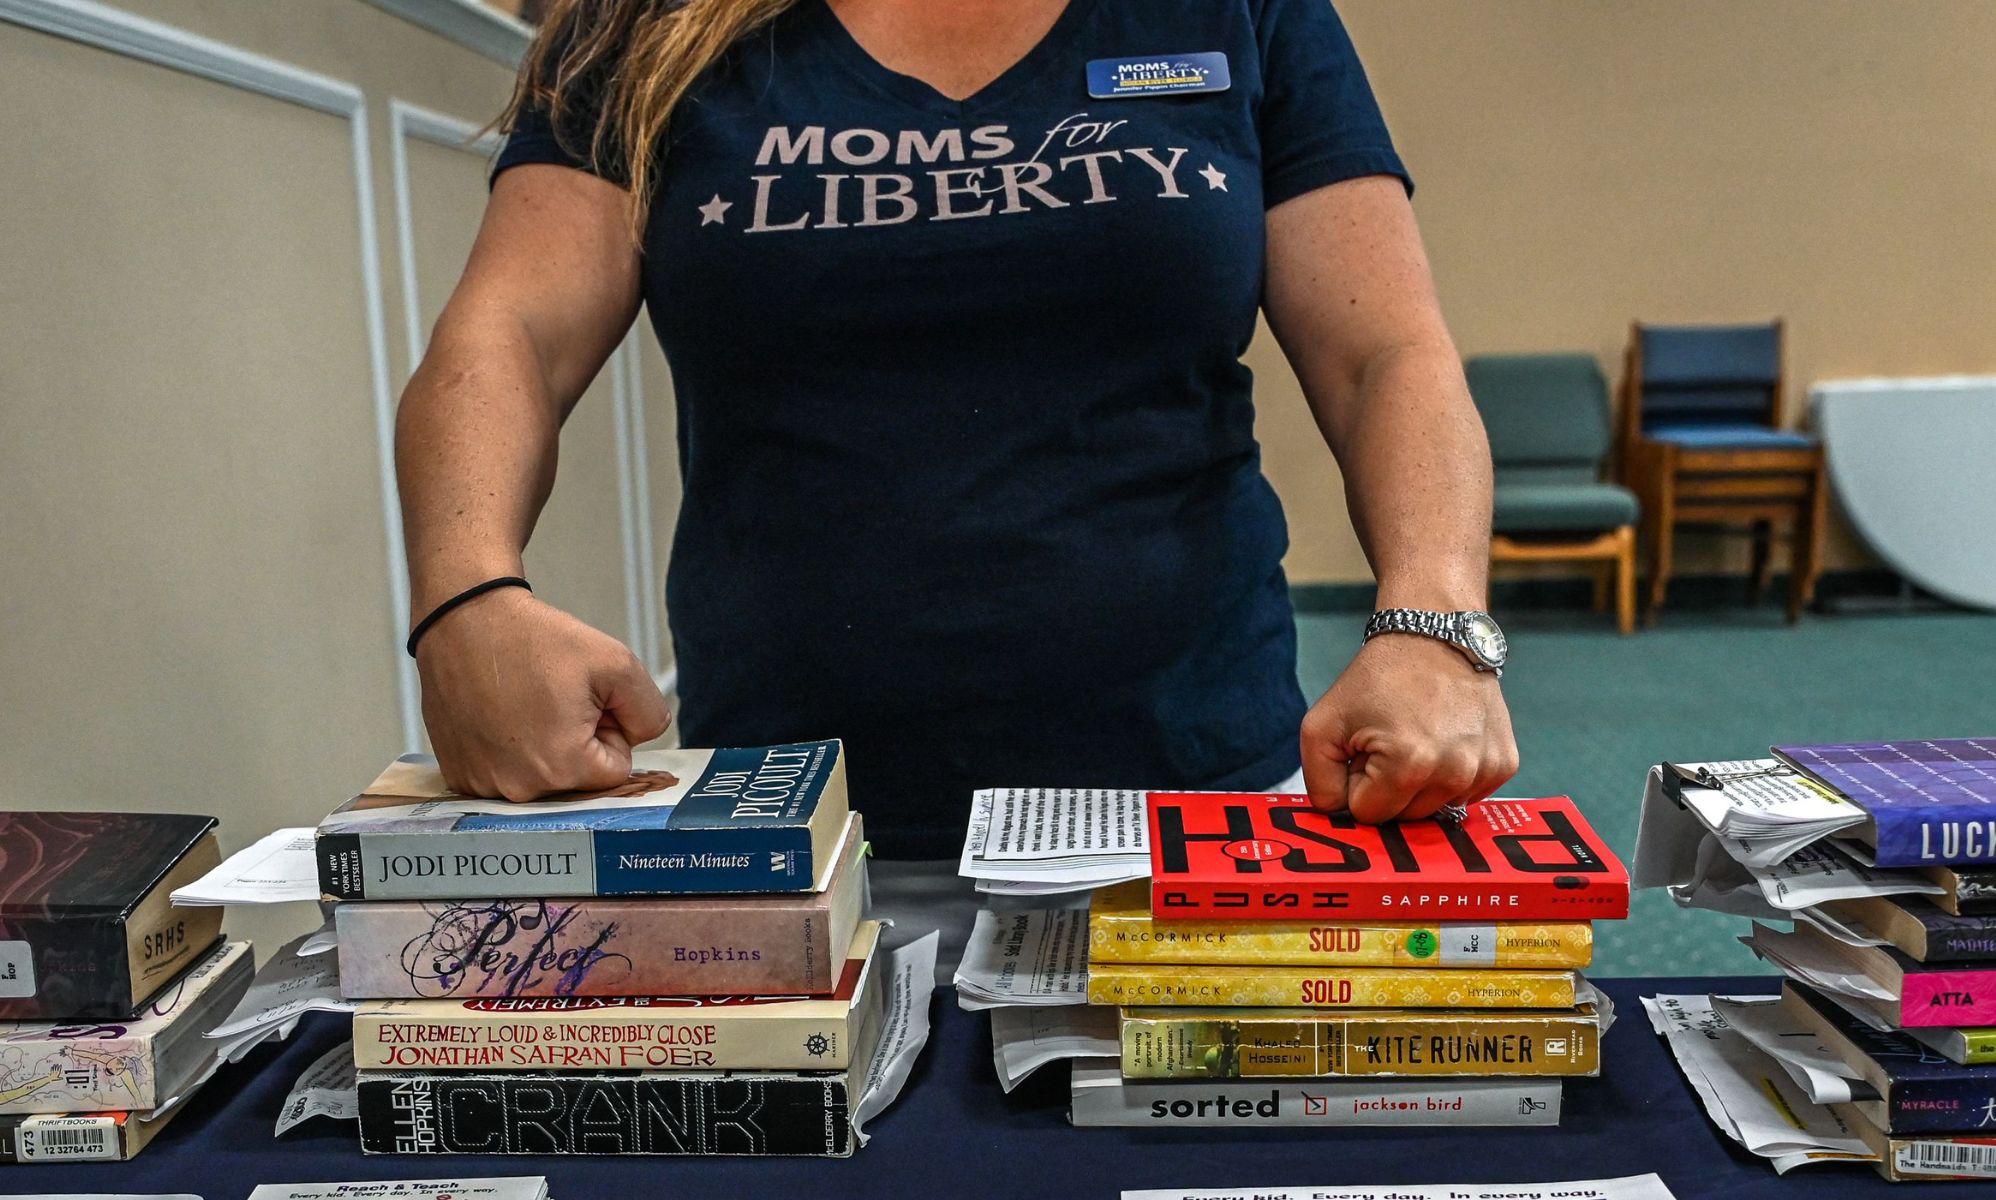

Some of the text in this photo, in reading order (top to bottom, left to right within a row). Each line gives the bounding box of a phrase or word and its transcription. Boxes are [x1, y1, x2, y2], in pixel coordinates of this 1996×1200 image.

[1118, 62, 1169, 73] MOMS
[1120, 68, 1203, 81] LIBERTY
[754, 124, 1015, 166] MOMS
[743, 147, 1190, 234] LIBERTY
[690, 770, 752, 799] JODI
[731, 749, 811, 819] PICOULT
[351, 850, 360, 891] BESTSELLER
[379, 853, 577, 882] JODI PICOULT
[618, 852, 750, 869] Nineteen Minutes
[340, 852, 350, 894] YORK TIMES
[1164, 892, 1349, 909] PUSH
[1382, 894, 1519, 906] SAPPHIRE
[144, 921, 185, 959] SRHS
[804, 917, 812, 943] Books
[1116, 927, 1361, 952] McCORMICK SOLD
[402, 901, 632, 998] Perfect
[674, 947, 761, 963] Hopkins
[1471, 934, 1479, 953] MCC
[1506, 938, 1561, 949] HYPERION
[8, 963, 16, 979] HOP
[1113, 979, 1520, 1004] McCORMICK SOLD HYPERION
[1930, 993, 1974, 1007] ATTA
[379, 1024, 717, 1045] EXTREMELY LOUD & INCREDIBLY CLOSE
[1134, 1032, 1142, 1056] moving
[1254, 1038, 1301, 1049] KHALED
[380, 1046, 717, 1066] JONATHAN SAFRAN FOER
[1248, 1053, 1306, 1064] HOSSEINI
[1367, 1035, 1422, 1064] KITE
[1431, 1035, 1532, 1064] RUNNER
[825, 1080, 833, 1108] BOOKS
[1151, 1089, 1462, 1118] sorted jackson bird
[1901, 1100, 1960, 1110] MYRACLE
[37, 1118, 98, 1126] THRIFTBOOKS
[392, 1079, 418, 1153] ELLEN
[413, 1079, 436, 1153] HOPKINS
[436, 1080, 766, 1153] CRANK
[24, 1130, 35, 1156] 473
[45, 1147, 55, 1155] 12
[57, 1146, 85, 1154] 32764
[87, 1145, 104, 1153] 473
[1900, 1160, 1915, 1168] The
[1920, 1161, 1966, 1171] Handmaids
[337, 1184, 389, 1192] Reach
[412, 1182, 459, 1190] Teach
[1312, 1192, 1375, 1200] Every
[1383, 1192, 1431, 1200] day.
[1450, 1192, 1470, 1200] In
[1478, 1192, 1542, 1200] every
[1550, 1190, 1604, 1199] way.
